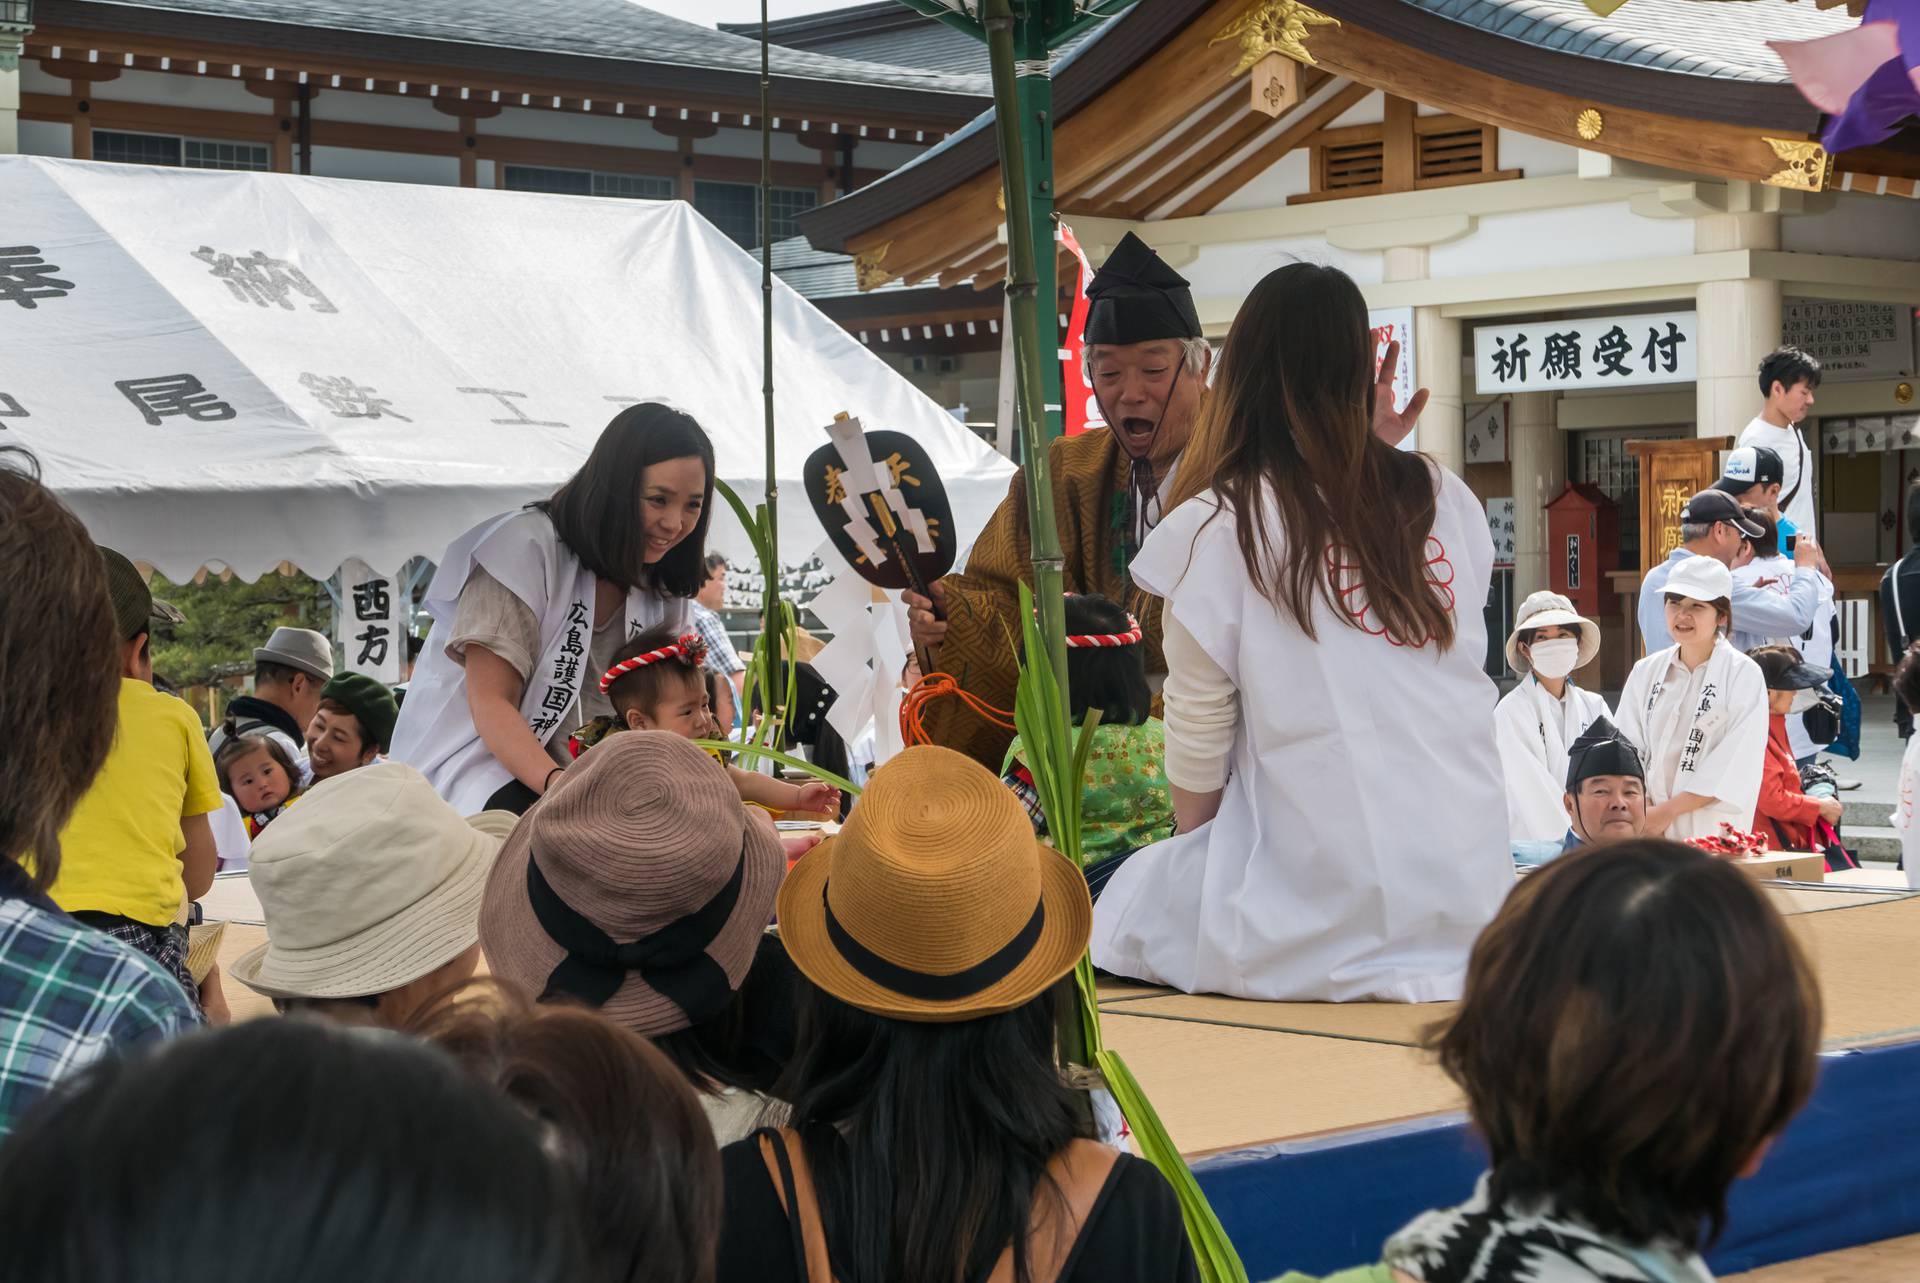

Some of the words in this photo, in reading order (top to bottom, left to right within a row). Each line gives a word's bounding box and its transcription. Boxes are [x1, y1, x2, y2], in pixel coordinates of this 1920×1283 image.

[1790, 321, 1801, 330] 28
[1804, 320, 1813, 330] 31
[1816, 319, 1827, 329] 40
[1829, 319, 1841, 329] 46
[1842, 319, 1853, 328] 51
[1855, 317, 1866, 327] 52
[1869, 317, 1880, 326] 55
[1791, 308, 1797, 317] 4
[1804, 307, 1811, 316] 6
[1817, 306, 1824, 315] 7
[1830, 305, 1839, 315] 10
[1842, 305, 1853, 314] 13
[1855, 304, 1865, 313] 15
[1791, 335, 1801, 345] 61
[1804, 334, 1815, 344] 64
[1817, 333, 1828, 343] 67
[1844, 331, 1855, 341] 70
[1857, 330, 1867, 340] 73
[1491, 322, 1687, 383] 祈願受付
[1844, 345, 1854, 354] 91
[0, 371, 672, 430] 尾鉄工
[1570, 537, 1578, 587] おみくじ
[352, 579, 390, 666] 西方
[530, 599, 589, 742] 広島護国神
[1680, 683, 1717, 772] 広島国神社
